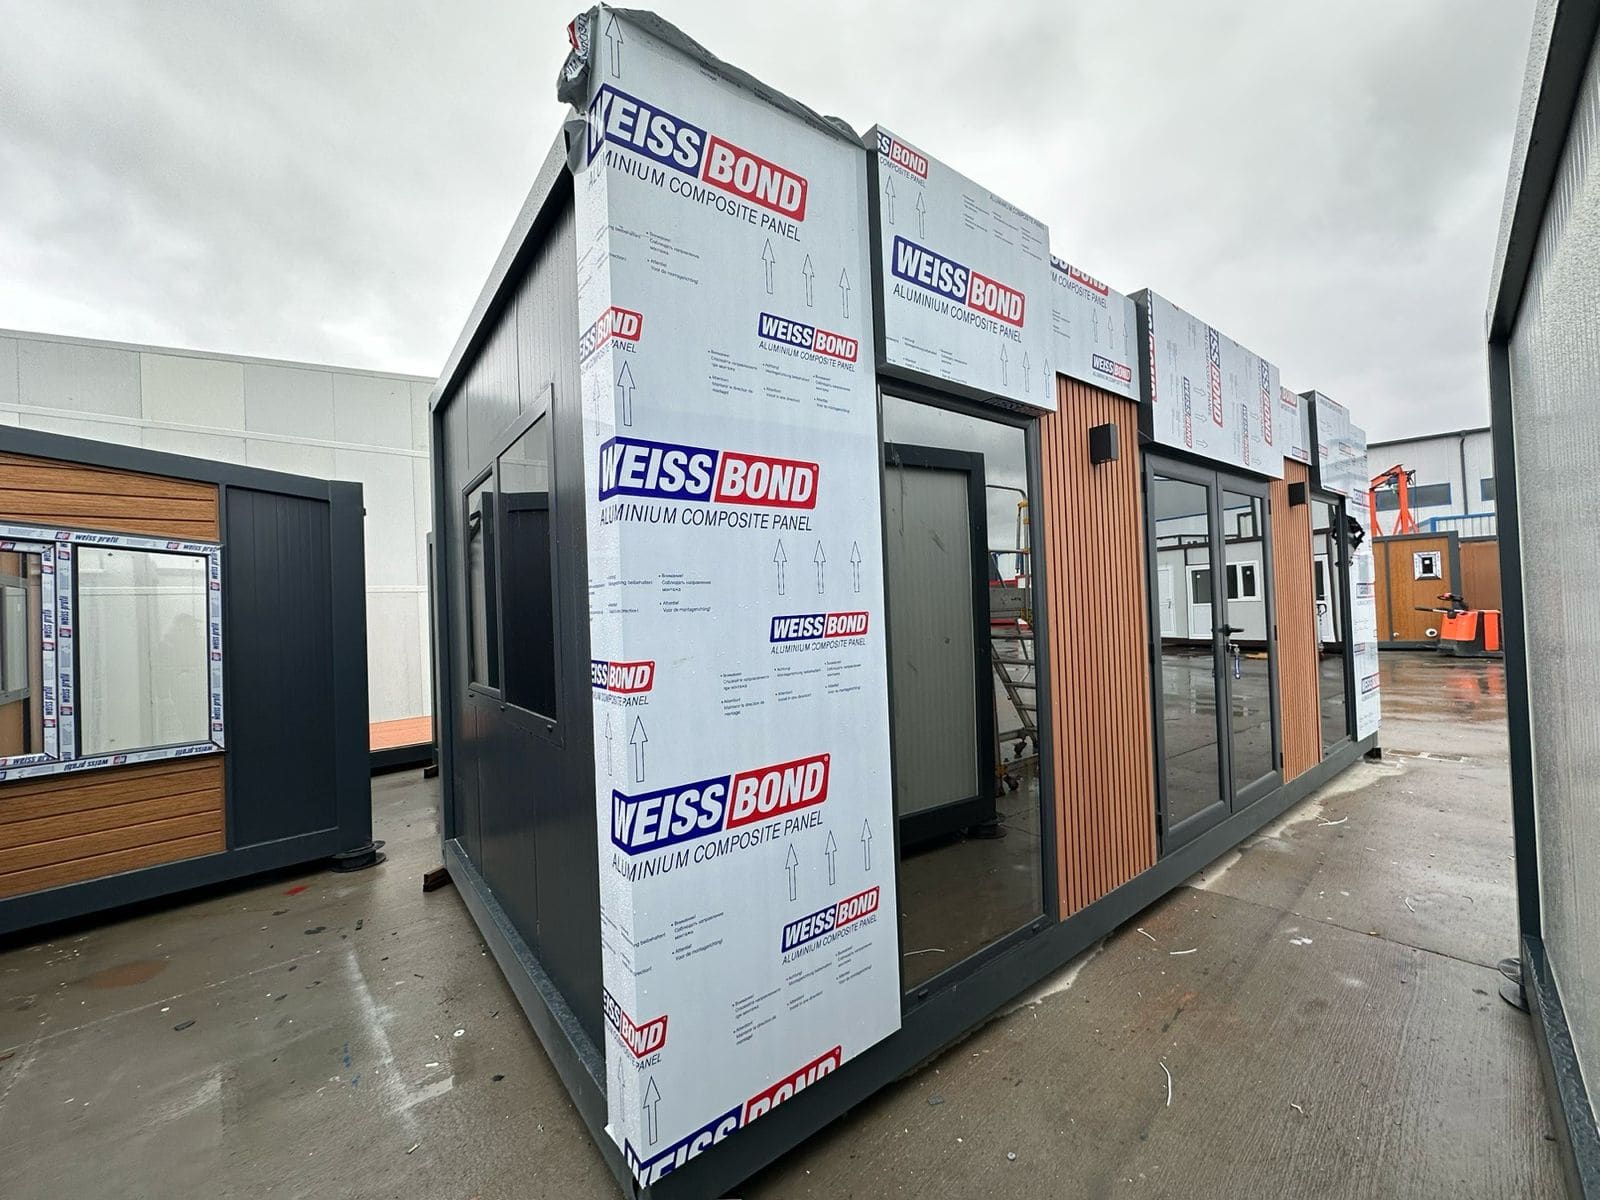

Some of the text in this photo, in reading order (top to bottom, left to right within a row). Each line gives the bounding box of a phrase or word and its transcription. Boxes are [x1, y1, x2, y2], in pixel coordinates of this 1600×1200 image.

[708, 143, 802, 213] BOND
[892, 143, 926, 174] BOND
[590, 149, 800, 241] MINIUM COMPOSITE PANEL
[897, 241, 967, 298] WEISS
[971, 277, 1021, 321] BOND
[597, 311, 638, 345] BOND
[893, 283, 1022, 343] ALUMINIUM COMPOSITE PANEL
[759, 341, 856, 373] ALUMINIUM COMPOSITE PANEL
[761, 315, 812, 347] WEISS
[816, 333, 855, 359] BOND
[1094, 356, 1113, 373] WEISS
[1212, 367, 1222, 424] BOND
[602, 444, 813, 502] WEISS BOND
[600, 504, 812, 531] ALUMINIUM COMPOSITE PANEL
[771, 638, 866, 655] ALUMINIUM COMPOSITE PANEL
[774, 614, 867, 638] WEISS BOND
[592, 663, 651, 690] EISS BOND
[12, 756, 36, 765] weiss
[613, 761, 825, 848] WEISS BOND
[612, 810, 823, 882] ALUMINIUM COMPOSITE PANEL
[781, 940, 822, 966] ALUMINIUM
[822, 923, 859, 946] COMPOSITE
[858, 914, 877, 929] PANEL
[785, 890, 877, 948] WEISS BOND
[622, 1011, 664, 1055] BOND
